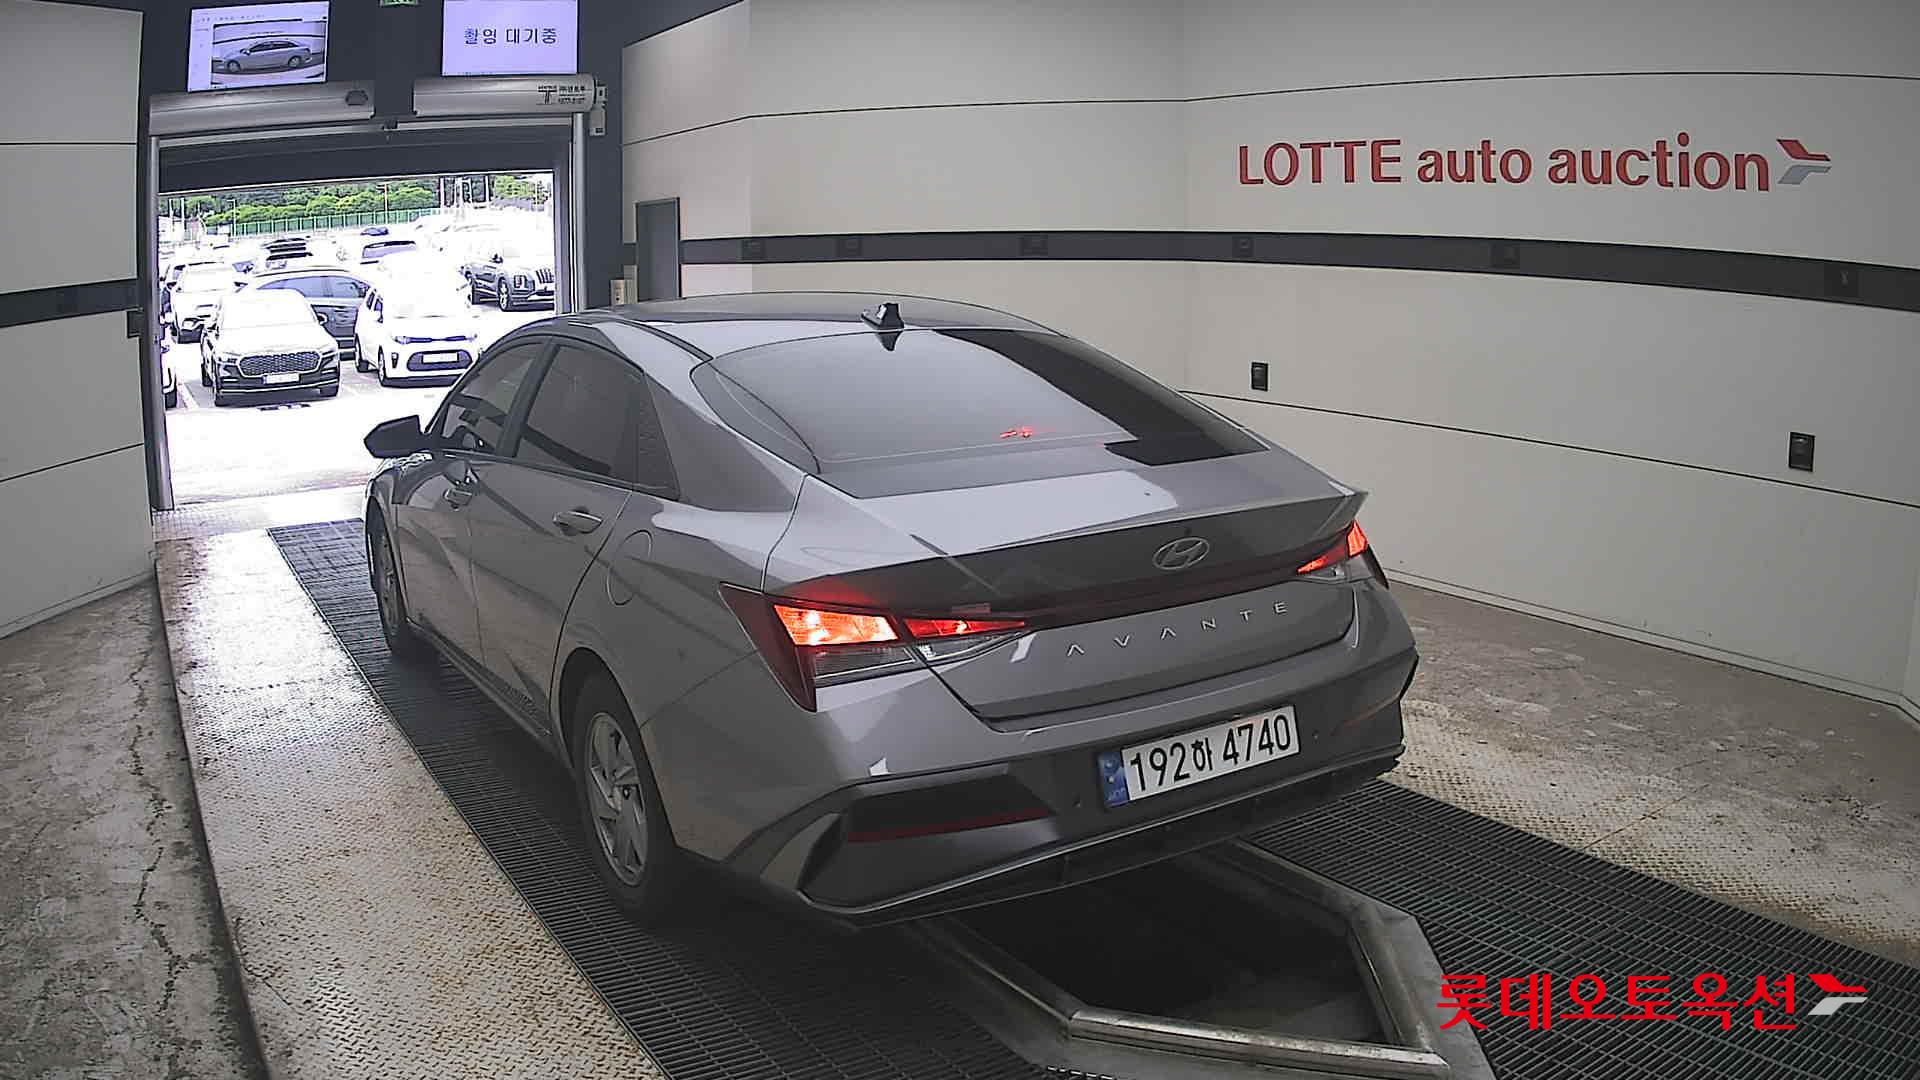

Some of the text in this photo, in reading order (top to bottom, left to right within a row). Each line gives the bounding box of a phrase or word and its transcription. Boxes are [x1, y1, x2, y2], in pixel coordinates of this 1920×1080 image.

[505, 28, 557, 44] 대기중
[1239, 132, 1769, 192] LOTTE auto auction
[1066, 601, 1288, 657] AVANTE
[1130, 714, 1291, 792] 192하 4740
